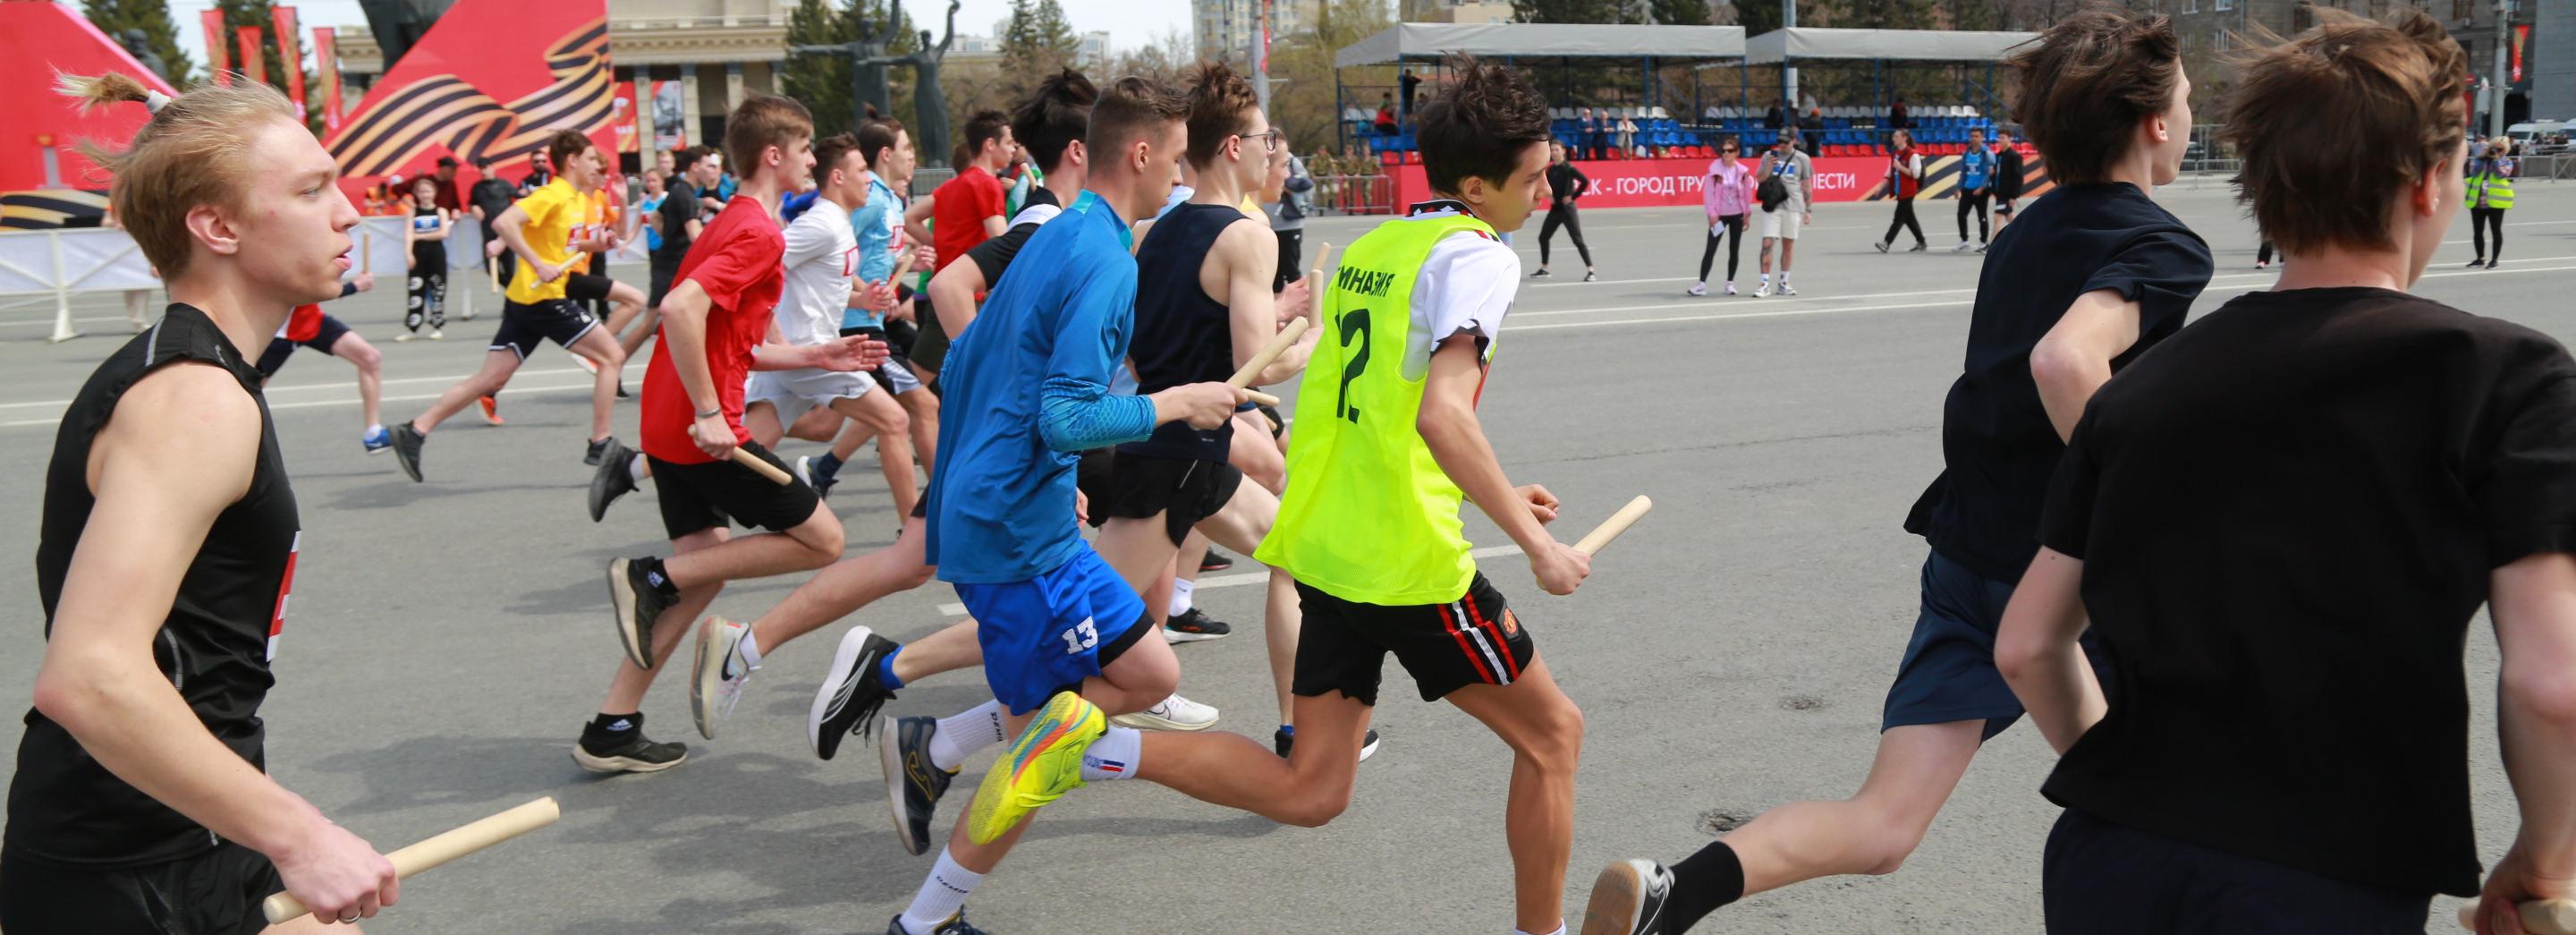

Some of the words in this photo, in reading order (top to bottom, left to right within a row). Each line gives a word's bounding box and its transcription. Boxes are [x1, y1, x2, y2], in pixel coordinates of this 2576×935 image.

[1616, 176, 1675, 196] ГОРОД
[1678, 175, 1706, 193] ТРУ
[1062, 616, 1098, 654] 13
[990, 711, 1004, 742] DEMI
